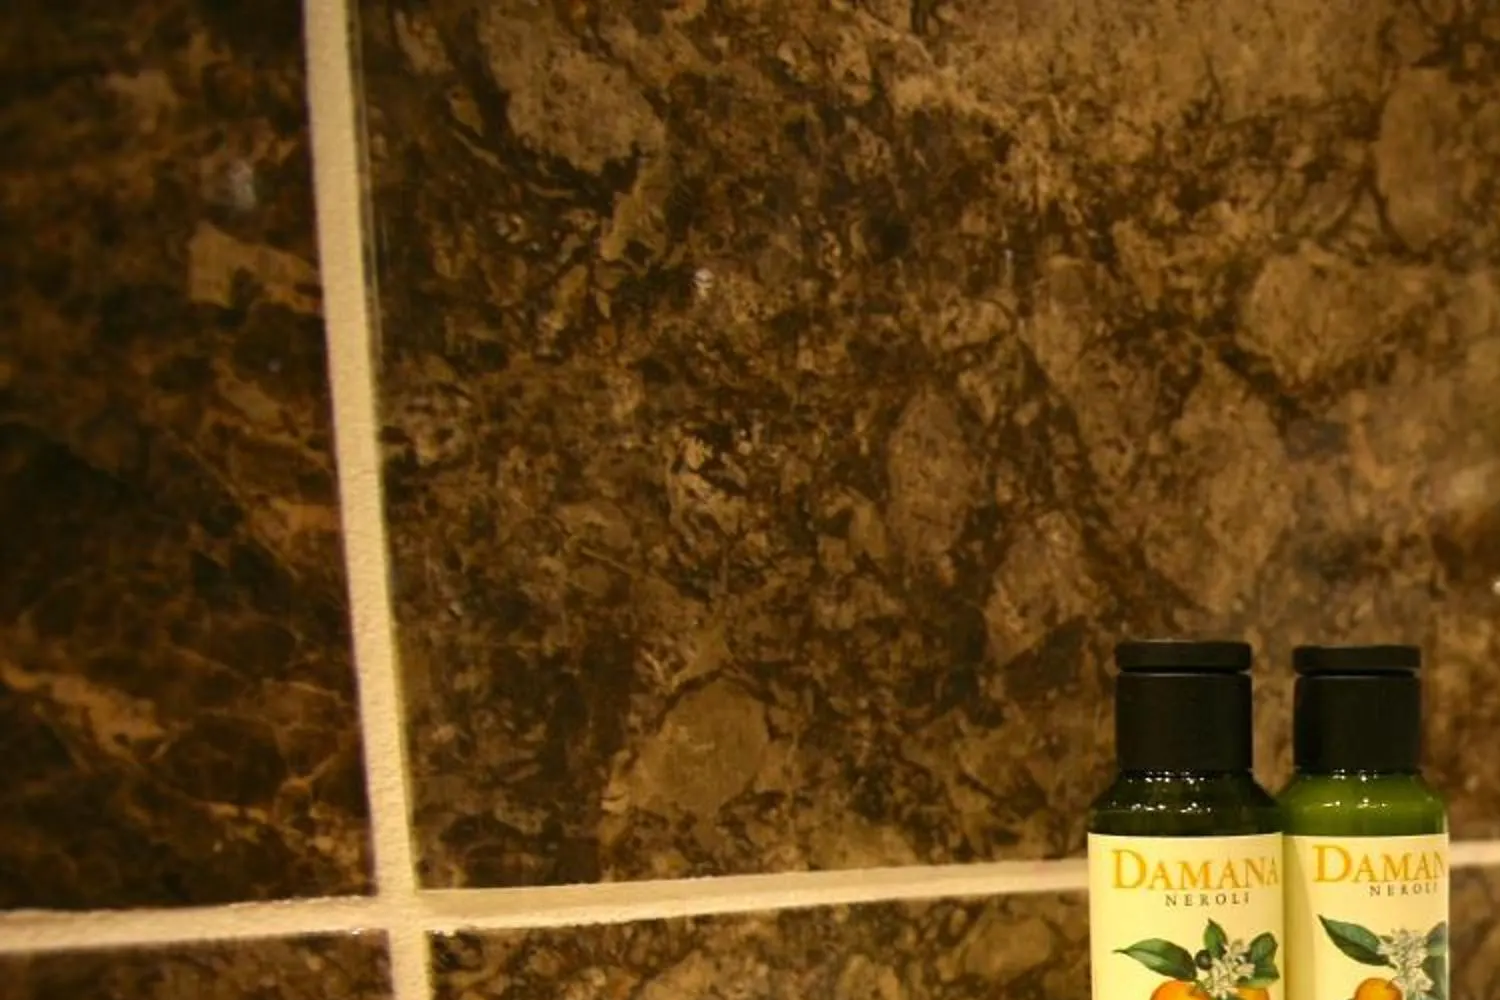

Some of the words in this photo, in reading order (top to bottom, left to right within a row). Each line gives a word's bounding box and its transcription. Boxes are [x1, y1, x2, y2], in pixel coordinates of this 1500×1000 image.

[1112, 848, 1280, 891] DAMANA
[1369, 882, 1438, 897] NEROLI
[1164, 892, 1250, 908] NEROLI
